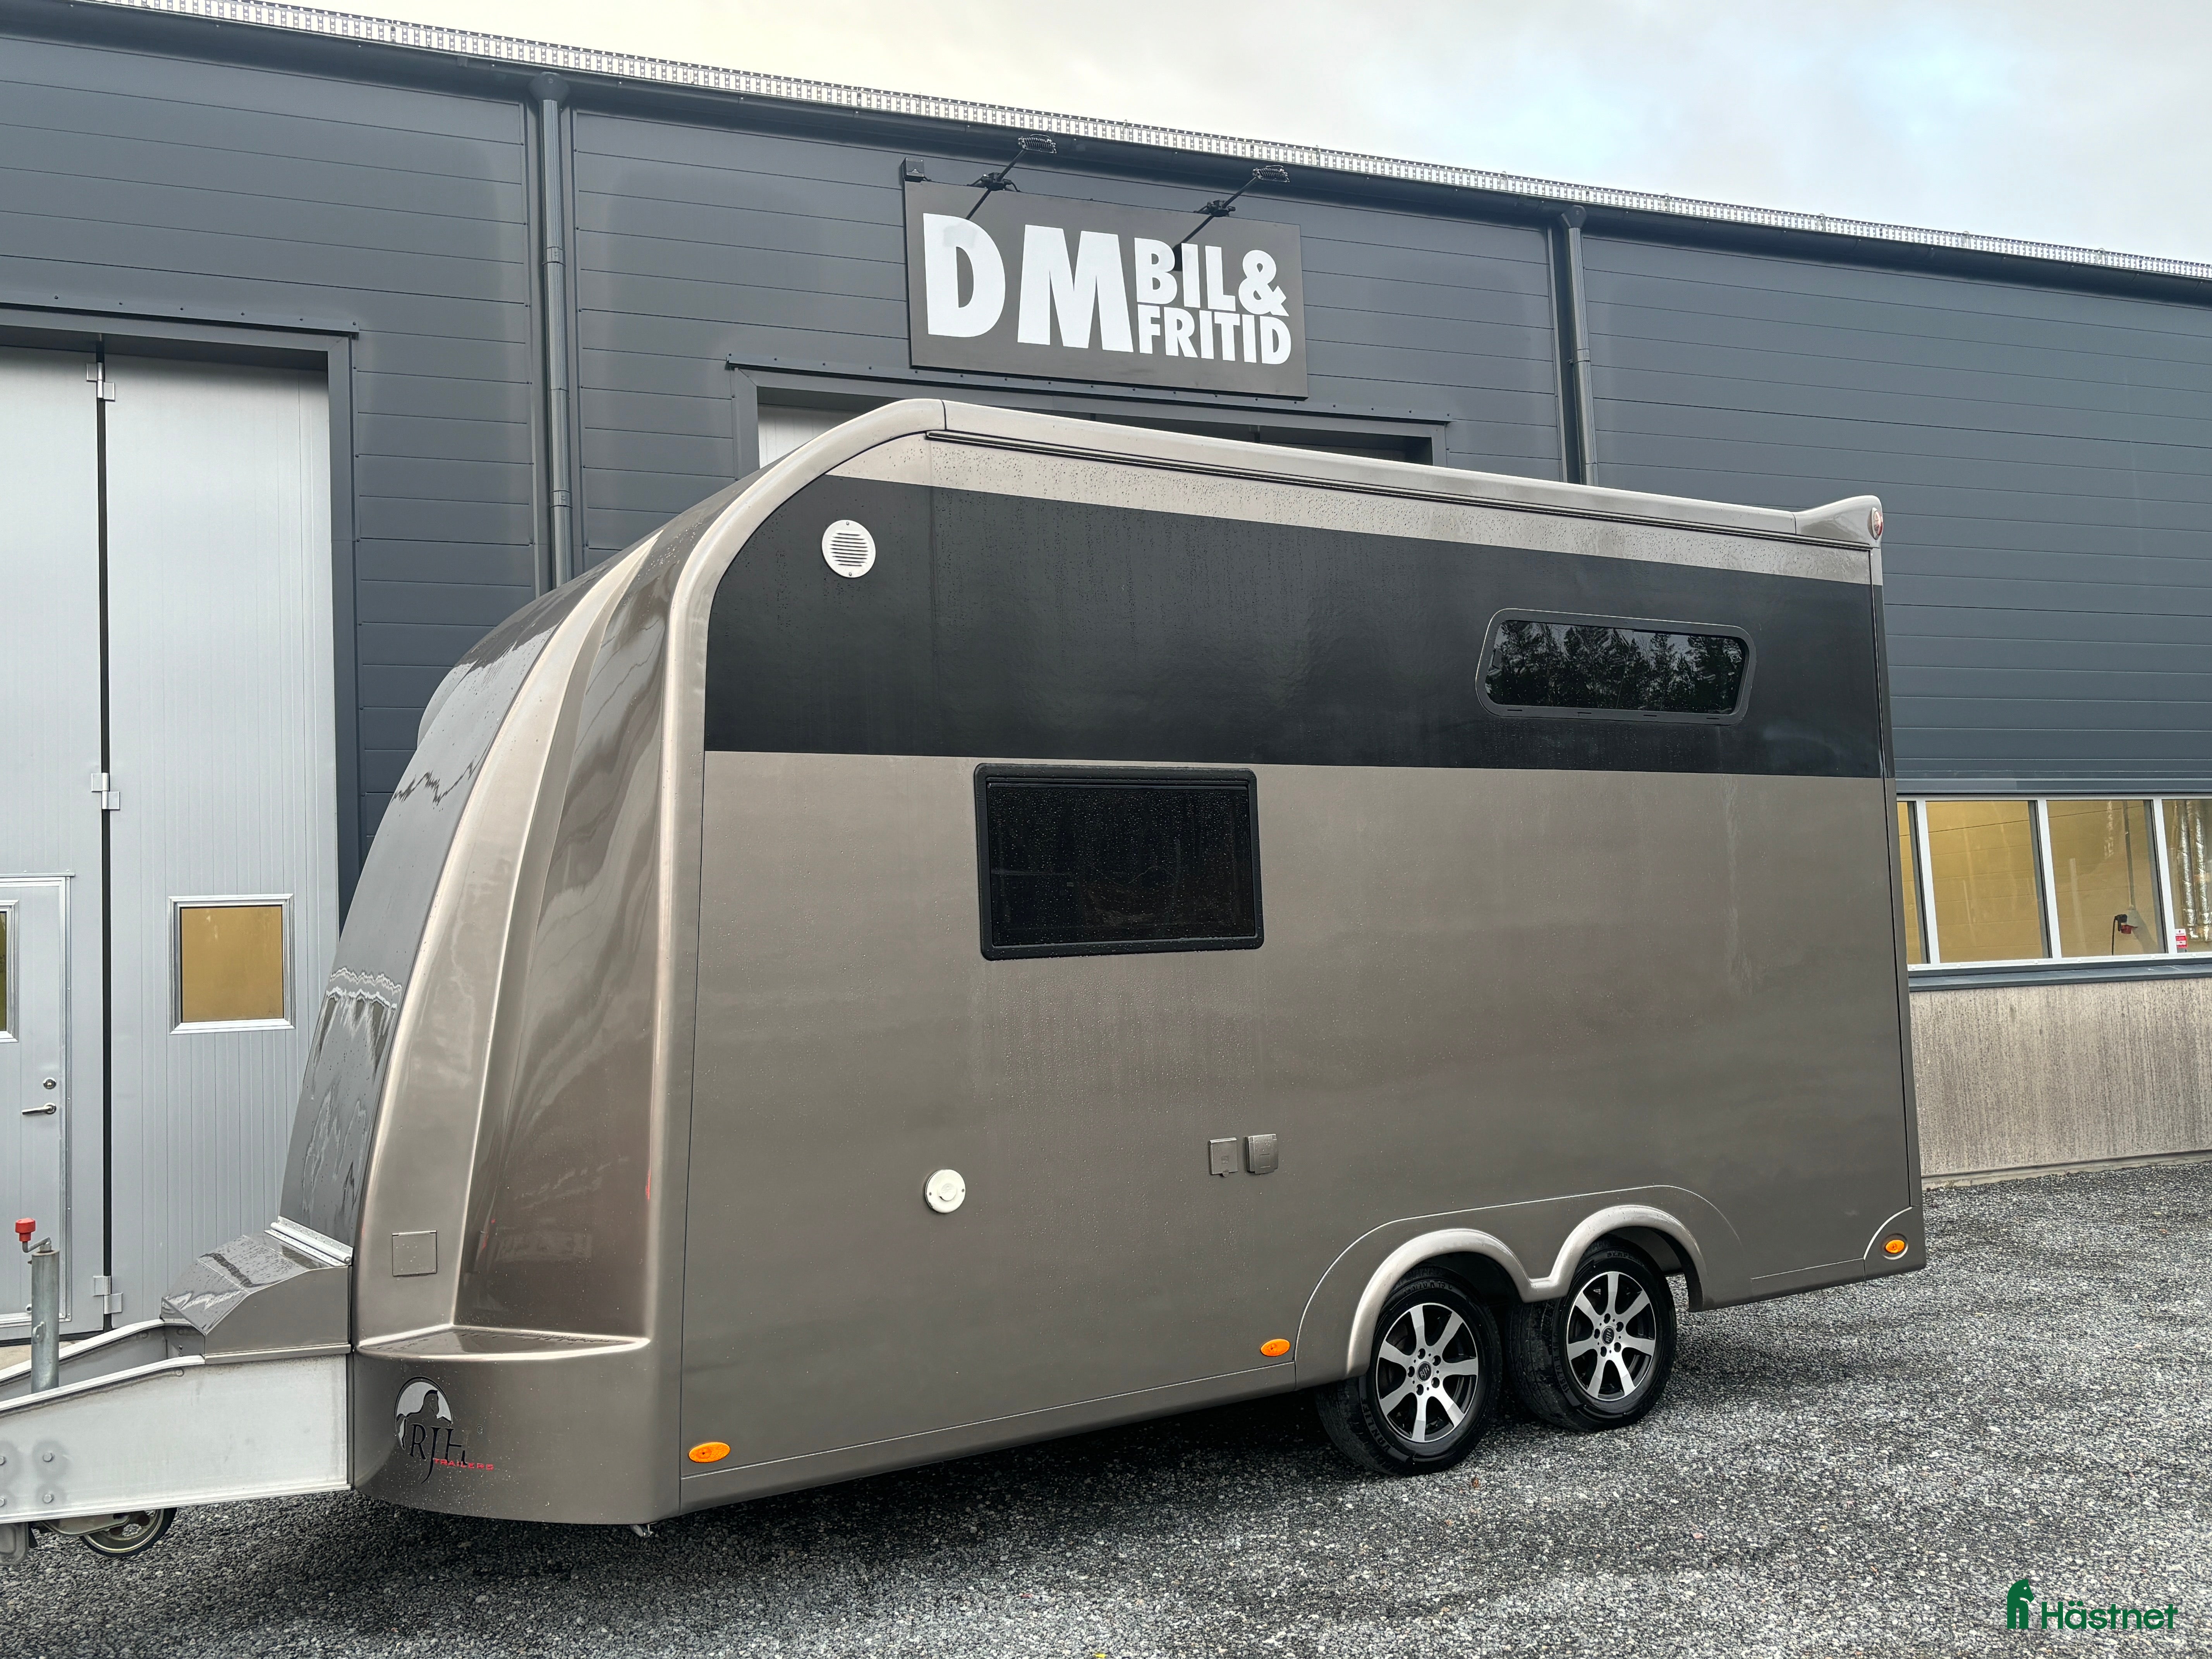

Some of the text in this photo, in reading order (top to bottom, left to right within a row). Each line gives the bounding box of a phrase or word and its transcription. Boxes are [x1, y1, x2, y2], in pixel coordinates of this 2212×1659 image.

[1137, 304, 1292, 365] FRITID
[1420, 1365, 1429, 1379] RJH
[409, 1423, 468, 1485] RJH
[433, 1458, 494, 1470] TRAILERS
